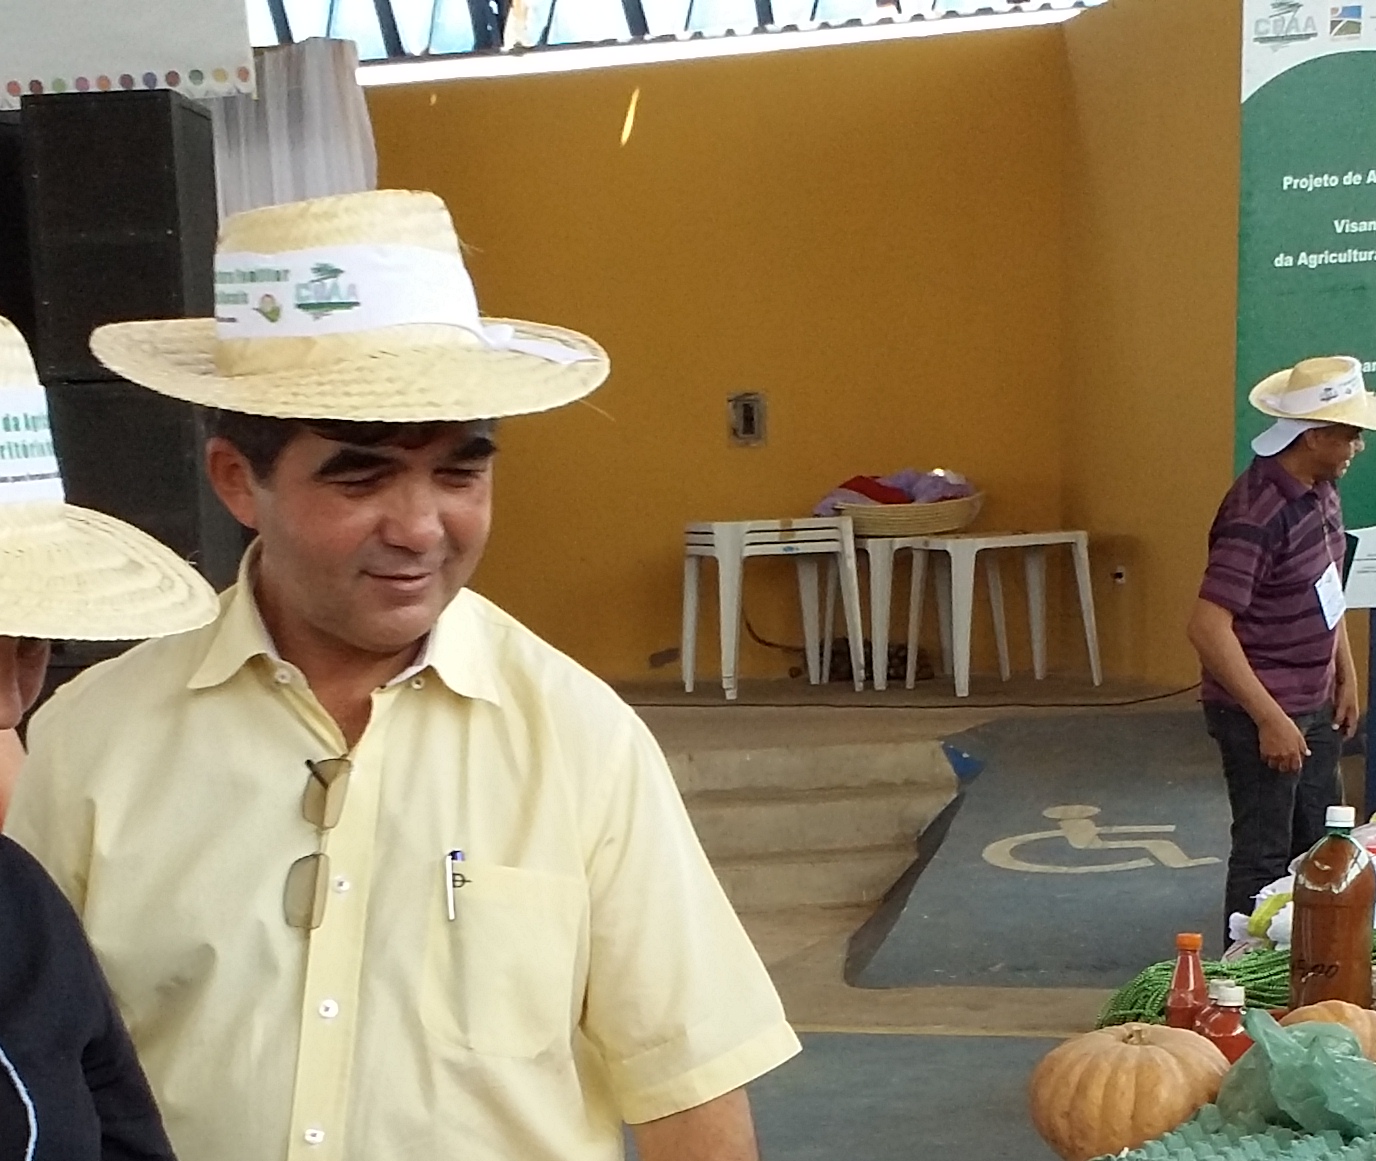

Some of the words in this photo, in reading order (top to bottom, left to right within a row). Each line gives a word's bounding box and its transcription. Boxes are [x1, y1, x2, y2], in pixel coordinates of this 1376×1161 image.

[1282, 174, 1339, 192] Projeto
[1343, 171, 1362, 186] de
[1274, 253, 1293, 268] da
